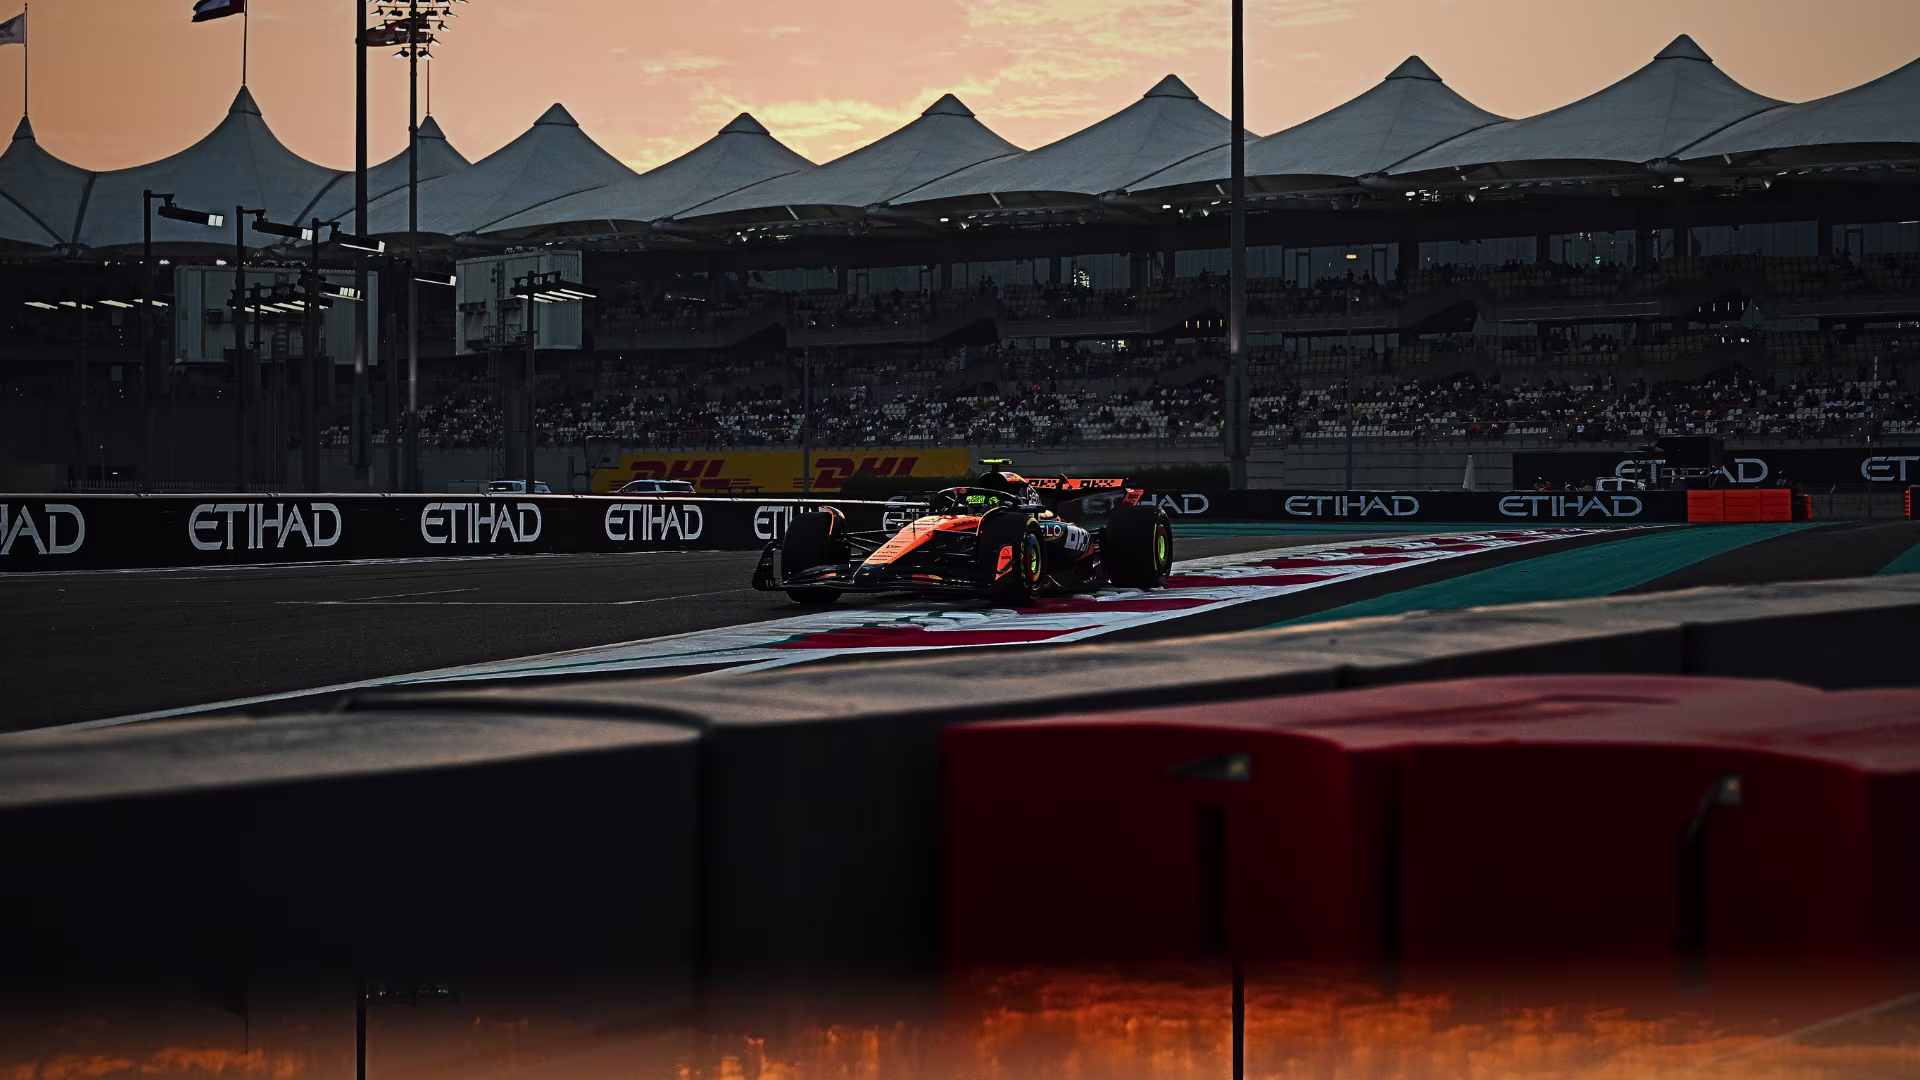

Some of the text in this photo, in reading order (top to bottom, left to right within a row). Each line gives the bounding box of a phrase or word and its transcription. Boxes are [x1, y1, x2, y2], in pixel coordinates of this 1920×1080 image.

[630, 459, 731, 488] DHL
[814, 456, 919, 488] DHL
[1615, 458, 1769, 483] ETAD
[1861, 455, 1920, 481] ET
[1284, 495, 1420, 516] ETIHAD
[1499, 495, 1643, 517] ETIHAD
[188, 502, 342, 550] ETIHAD
[420, 502, 542, 544] ETIHAD
[605, 503, 703, 540] ETIHAD
